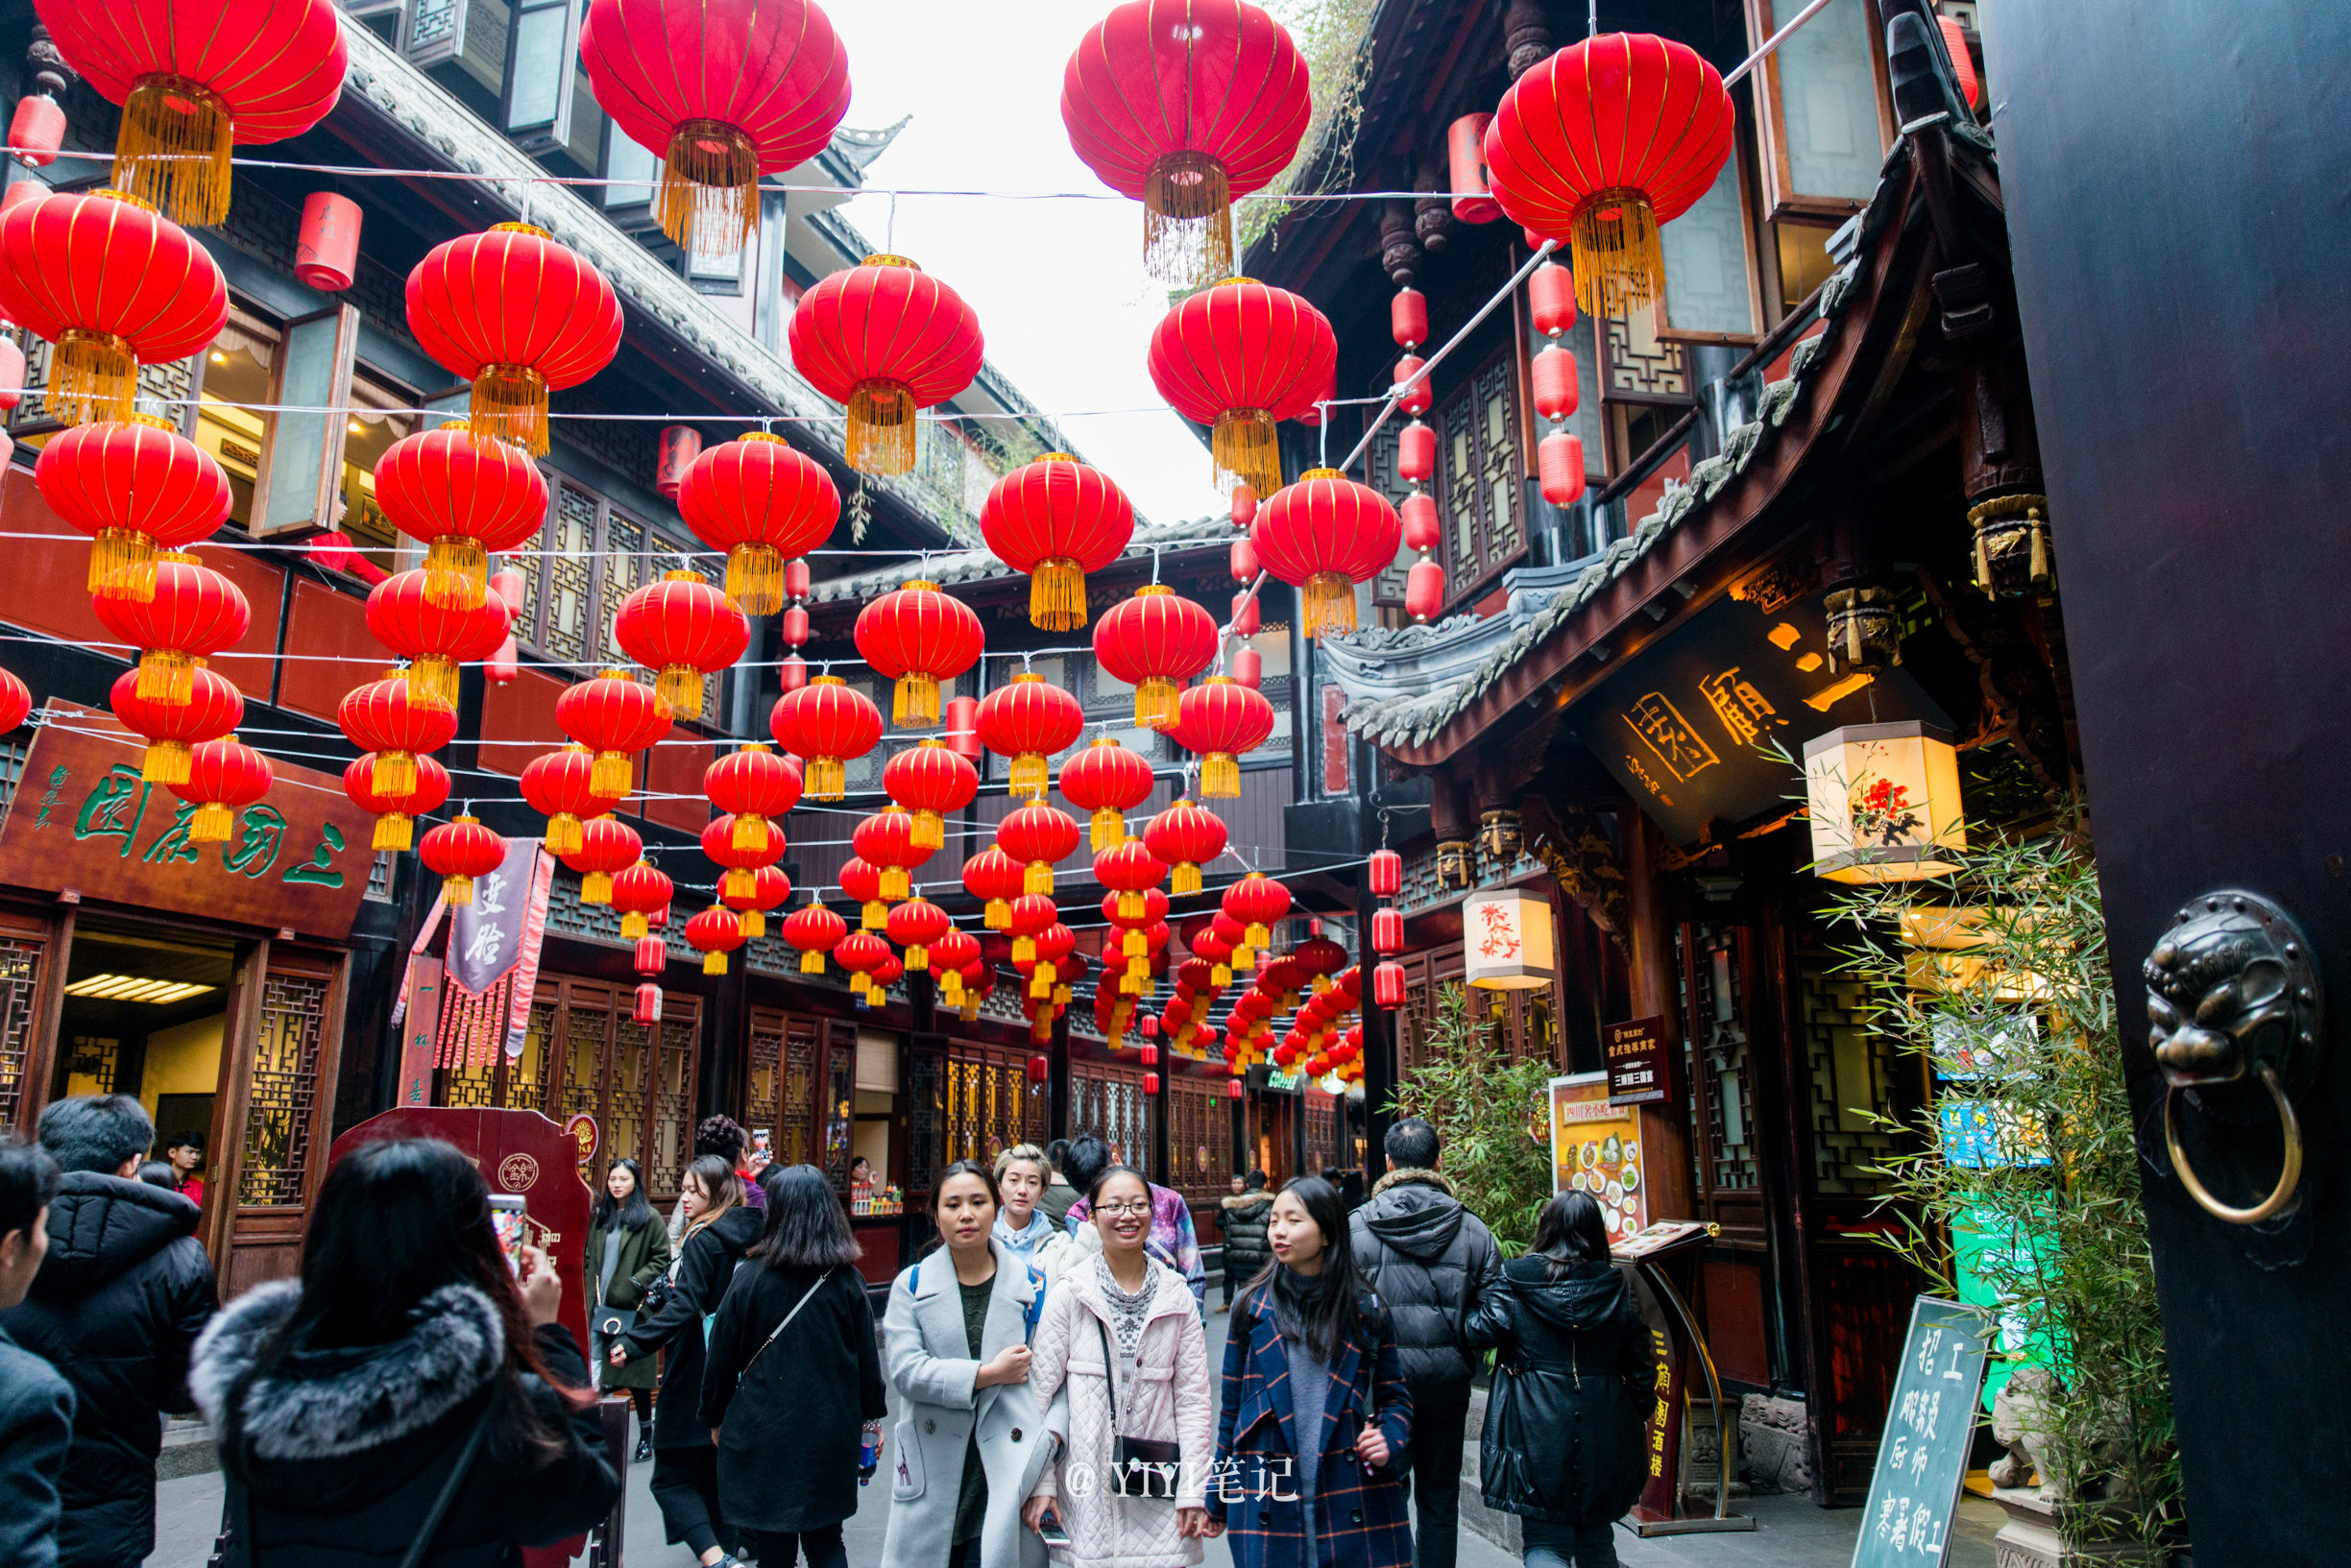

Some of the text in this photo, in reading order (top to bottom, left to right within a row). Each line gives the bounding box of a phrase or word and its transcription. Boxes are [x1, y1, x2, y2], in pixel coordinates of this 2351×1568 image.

[1919, 1328, 1964, 1382] 招工
[1889, 1435, 1928, 1487] 厨师
[1876, 1489, 1942, 1556] 寒暑假工
